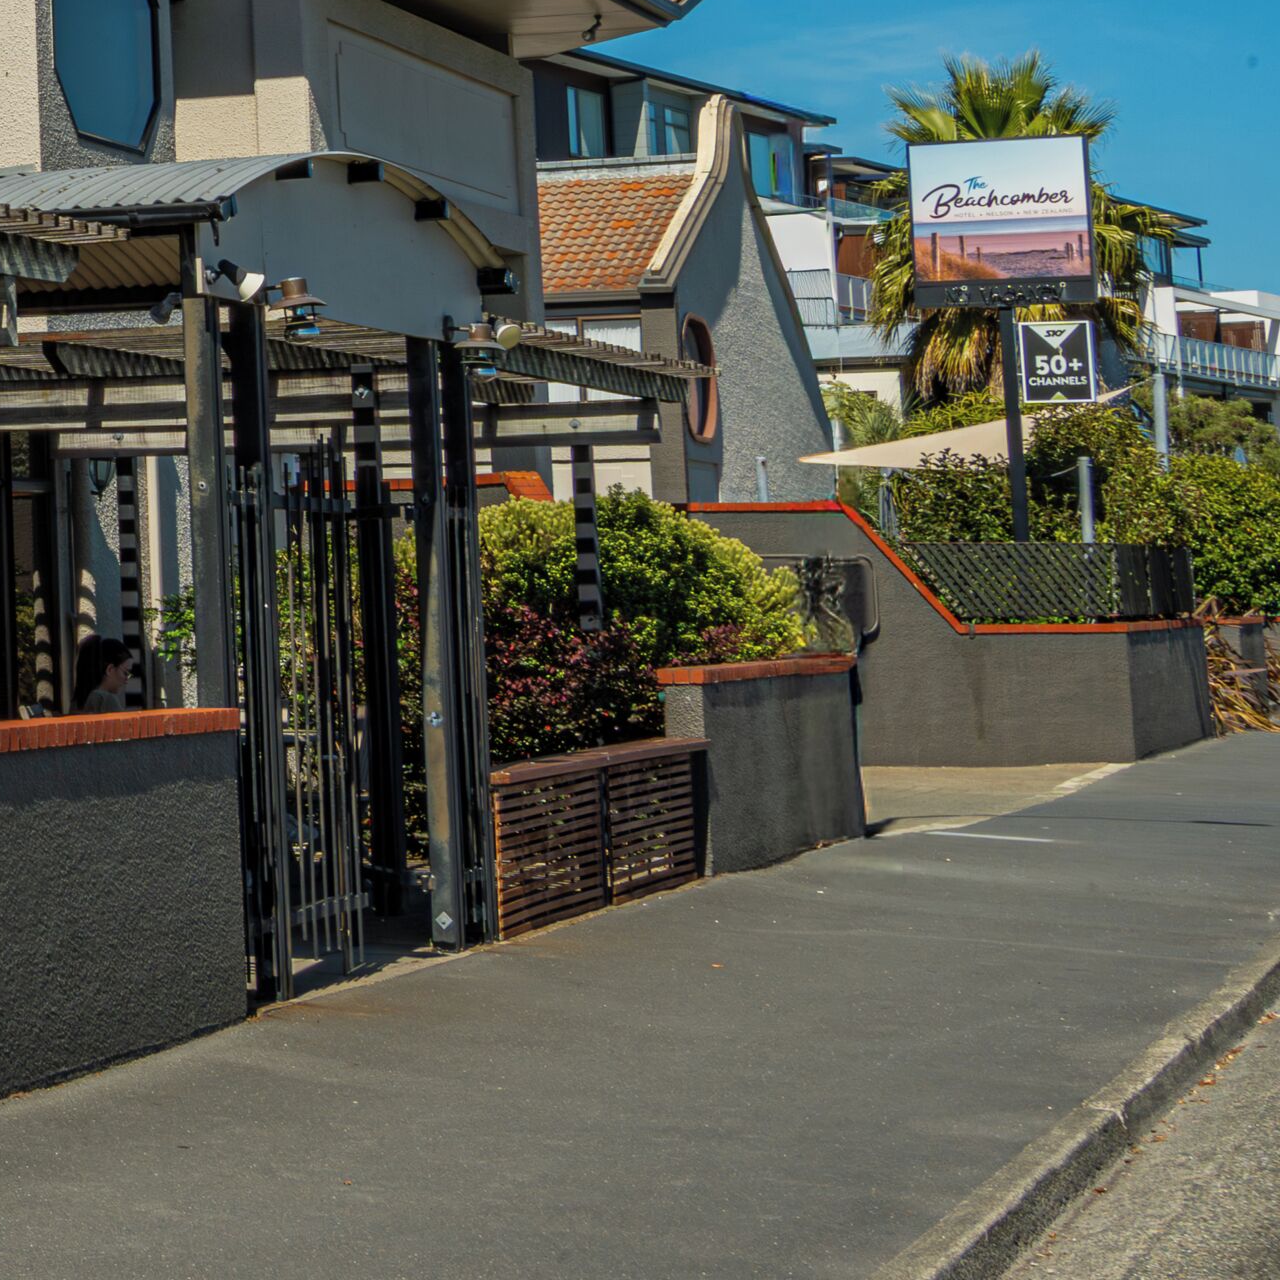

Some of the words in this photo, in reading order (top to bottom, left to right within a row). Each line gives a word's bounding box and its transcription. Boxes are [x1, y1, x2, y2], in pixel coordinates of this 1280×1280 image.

[963, 175, 988, 194] The
[921, 183, 1074, 219] Beachcomber
[1044, 329, 1066, 338] SKY
[1035, 355, 1083, 376] 50+
[1028, 376, 1088, 386] CHANNELS
